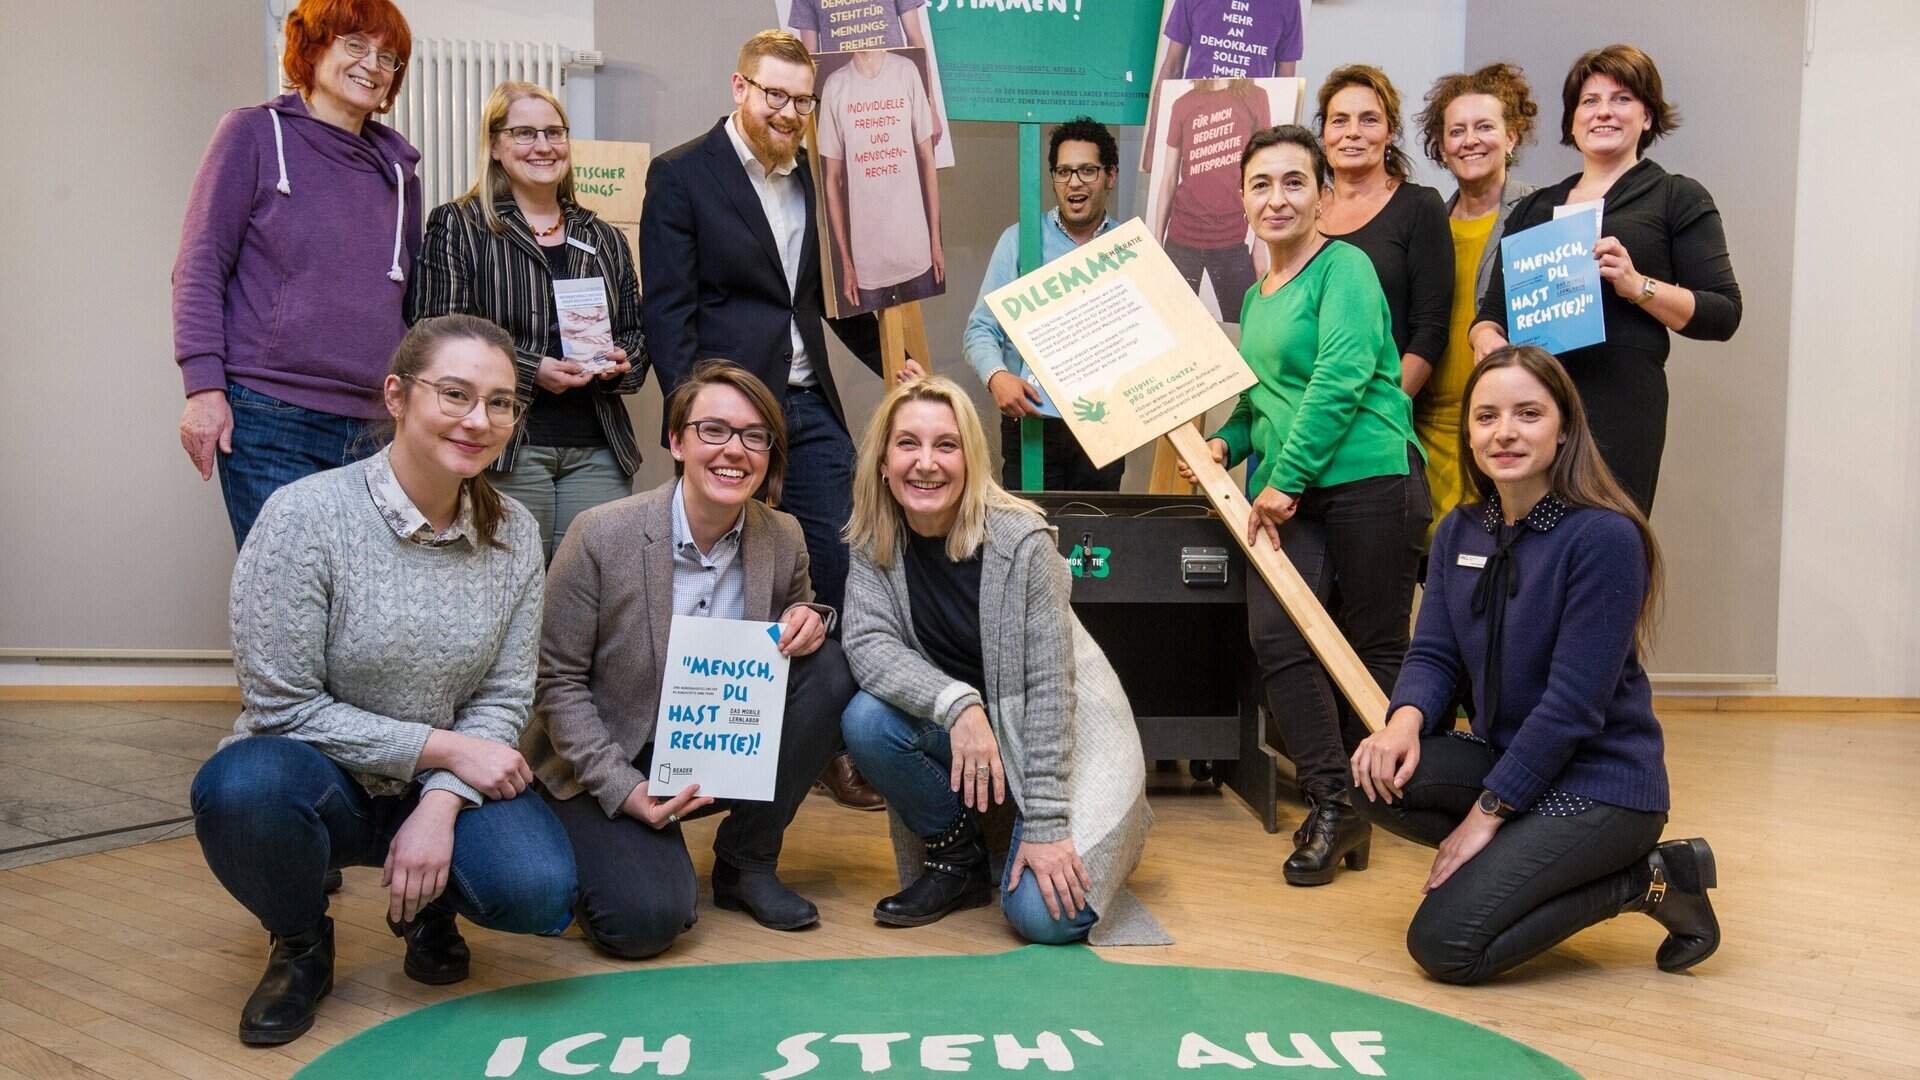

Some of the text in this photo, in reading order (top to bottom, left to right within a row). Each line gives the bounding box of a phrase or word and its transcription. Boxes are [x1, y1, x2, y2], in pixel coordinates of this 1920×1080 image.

[830, 4, 884, 23] STEHT FÜR
[1231, 0, 1249, 12] EIN
[1223, 13, 1253, 26] MEHR
[831, 20, 888, 38] MEINUNGS-
[1227, 27, 1244, 38] AN
[840, 35, 886, 52] FREIHEIT.
[1200, 35, 1268, 56] DEMOKRATIE
[1213, 51, 1251, 66] SOLLTE
[1212, 64, 1247, 78] IMMER
[847, 98, 905, 113] INDIVIDUELLE
[854, 115, 901, 129] FREIHEITS-
[1192, 107, 1232, 130] FÜR MICH
[870, 133, 890, 144] UND
[1193, 122, 1236, 144] BEDEUTET
[855, 149, 908, 163] MENSCHEN-
[1189, 136, 1242, 160] DEMOKRATIE
[865, 164, 901, 178] RECHTE.
[1190, 151, 1242, 176] MITSPRACHE
[575, 166, 625, 180] TISCHER
[1513, 241, 1588, 273] "MENSCH,
[1548, 264, 1569, 282] DU
[1001, 244, 1138, 321] DILEMMA
[1511, 286, 1549, 311] HAST
[1516, 294, 1593, 330] RECHT(E)!"
[683, 656, 775, 682] "MENSCH,
[723, 684, 748, 702] DU
[668, 705, 720, 726] HAST
[729, 716, 760, 724] LERNLABOR
[742, 708, 761, 716] MOBILE
[670, 731, 762, 756] RECHT(E)!
[485, 1033, 691, 1077] ICH
[1177, 1031, 1387, 1077] AUF
